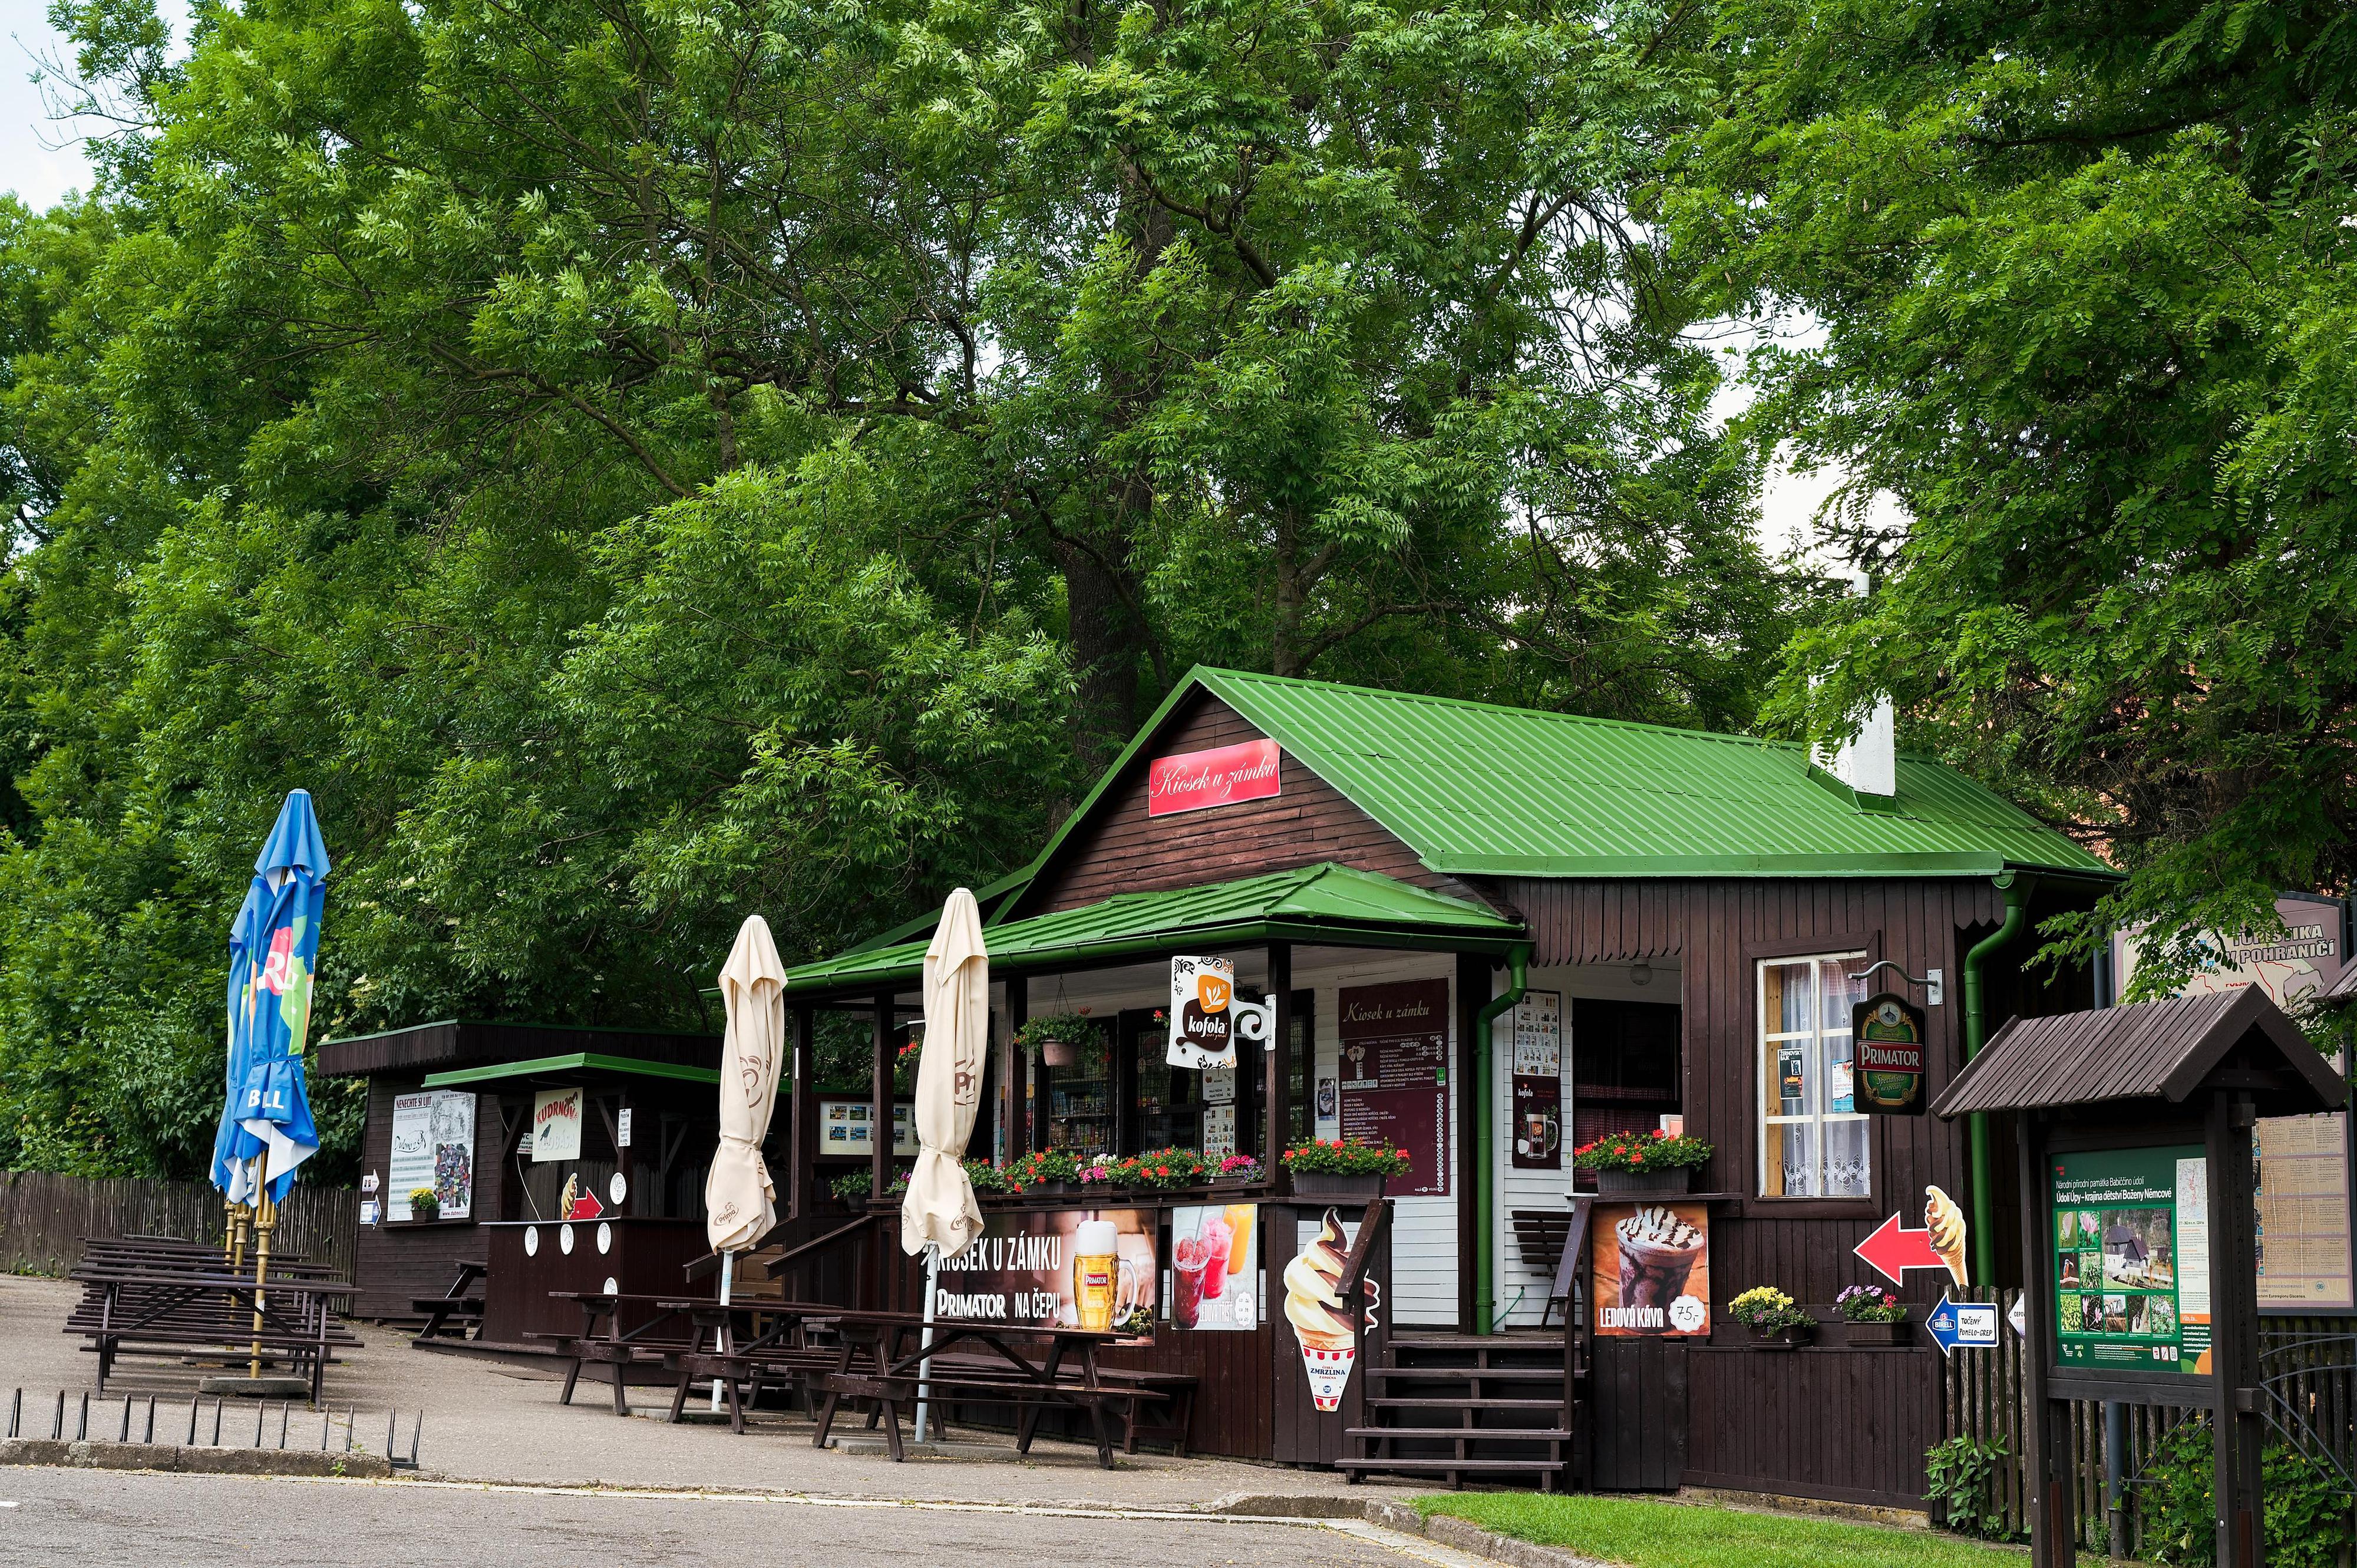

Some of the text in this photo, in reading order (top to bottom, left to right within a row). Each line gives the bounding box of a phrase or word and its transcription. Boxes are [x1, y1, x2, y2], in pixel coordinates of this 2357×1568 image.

[1151, 755, 1277, 798] Kiosek u zámku
[2240, 939, 2336, 964] POHRANIČÍ
[1342, 1002, 1382, 1022] Kiosek
[1396, 1000, 1430, 1018] zámku
[1188, 1015, 1226, 1038] kofola
[1206, 1032, 1227, 1041] original
[1876, 1074, 1905, 1086] Specialista
[1518, 1088, 1533, 1098] kofola
[396, 1098, 417, 1108] NENECHTE
[2056, 1176, 2144, 1189] Národní přírodní památka Babiččino údolí
[2056, 1191, 2070, 1203] Údolí
[2070, 1190, 2081, 1204] Úpy
[2085, 1191, 2103, 1203] krajina
[2103, 1189, 2122, 1201] dětství
[2123, 1189, 2144, 1201] Boženy
[2145, 1187, 2171, 1199] Němcové
[719, 1209, 736, 1223] Prima
[993, 1238, 1002, 1271] U
[1007, 1230, 1061, 1271] ZÁMKU
[1015, 1293, 1030, 1318] NA
[1032, 1287, 1060, 1318] ČEPU
[1199, 1302, 1218, 1322] LEDOVÁ
[1600, 1304, 1663, 1327] LEDOVÁ KÁVA
[1677, 1306, 1699, 1323] 75,-
[1961, 1316, 1981, 1325] TOČENÝ
